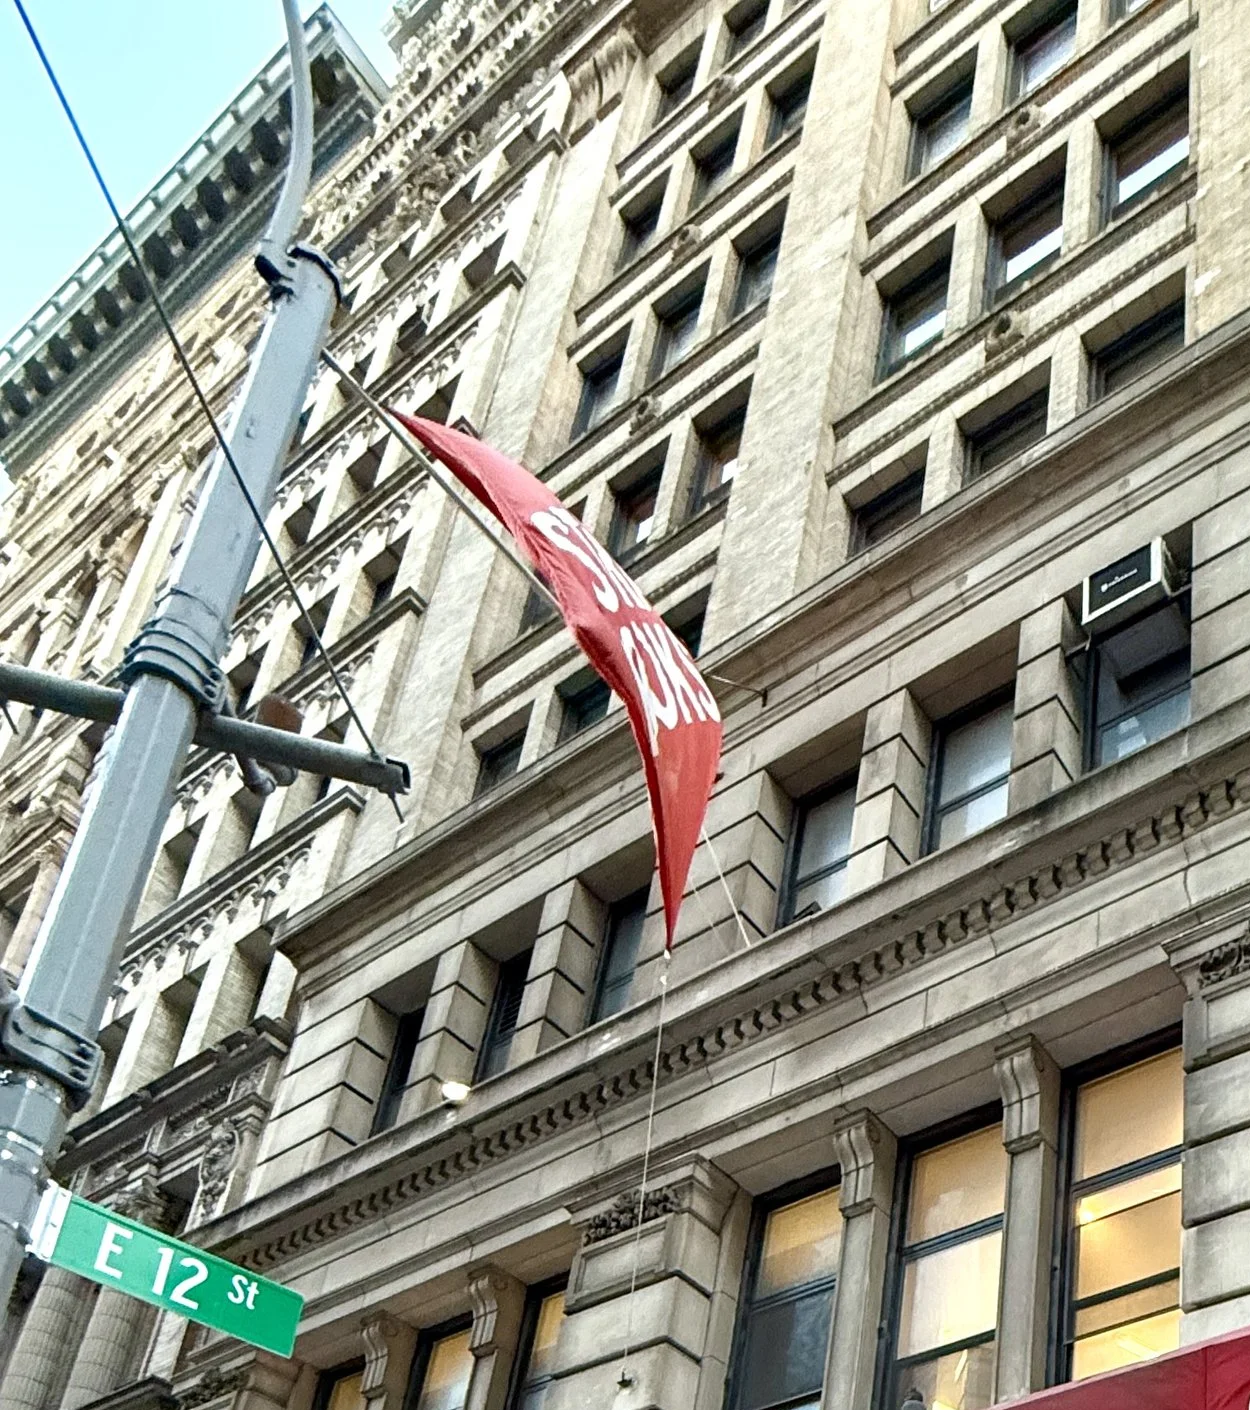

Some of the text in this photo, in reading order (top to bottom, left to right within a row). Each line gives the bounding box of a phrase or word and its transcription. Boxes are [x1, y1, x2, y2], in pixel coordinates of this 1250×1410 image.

[93, 1221, 260, 1311] E 12 St
